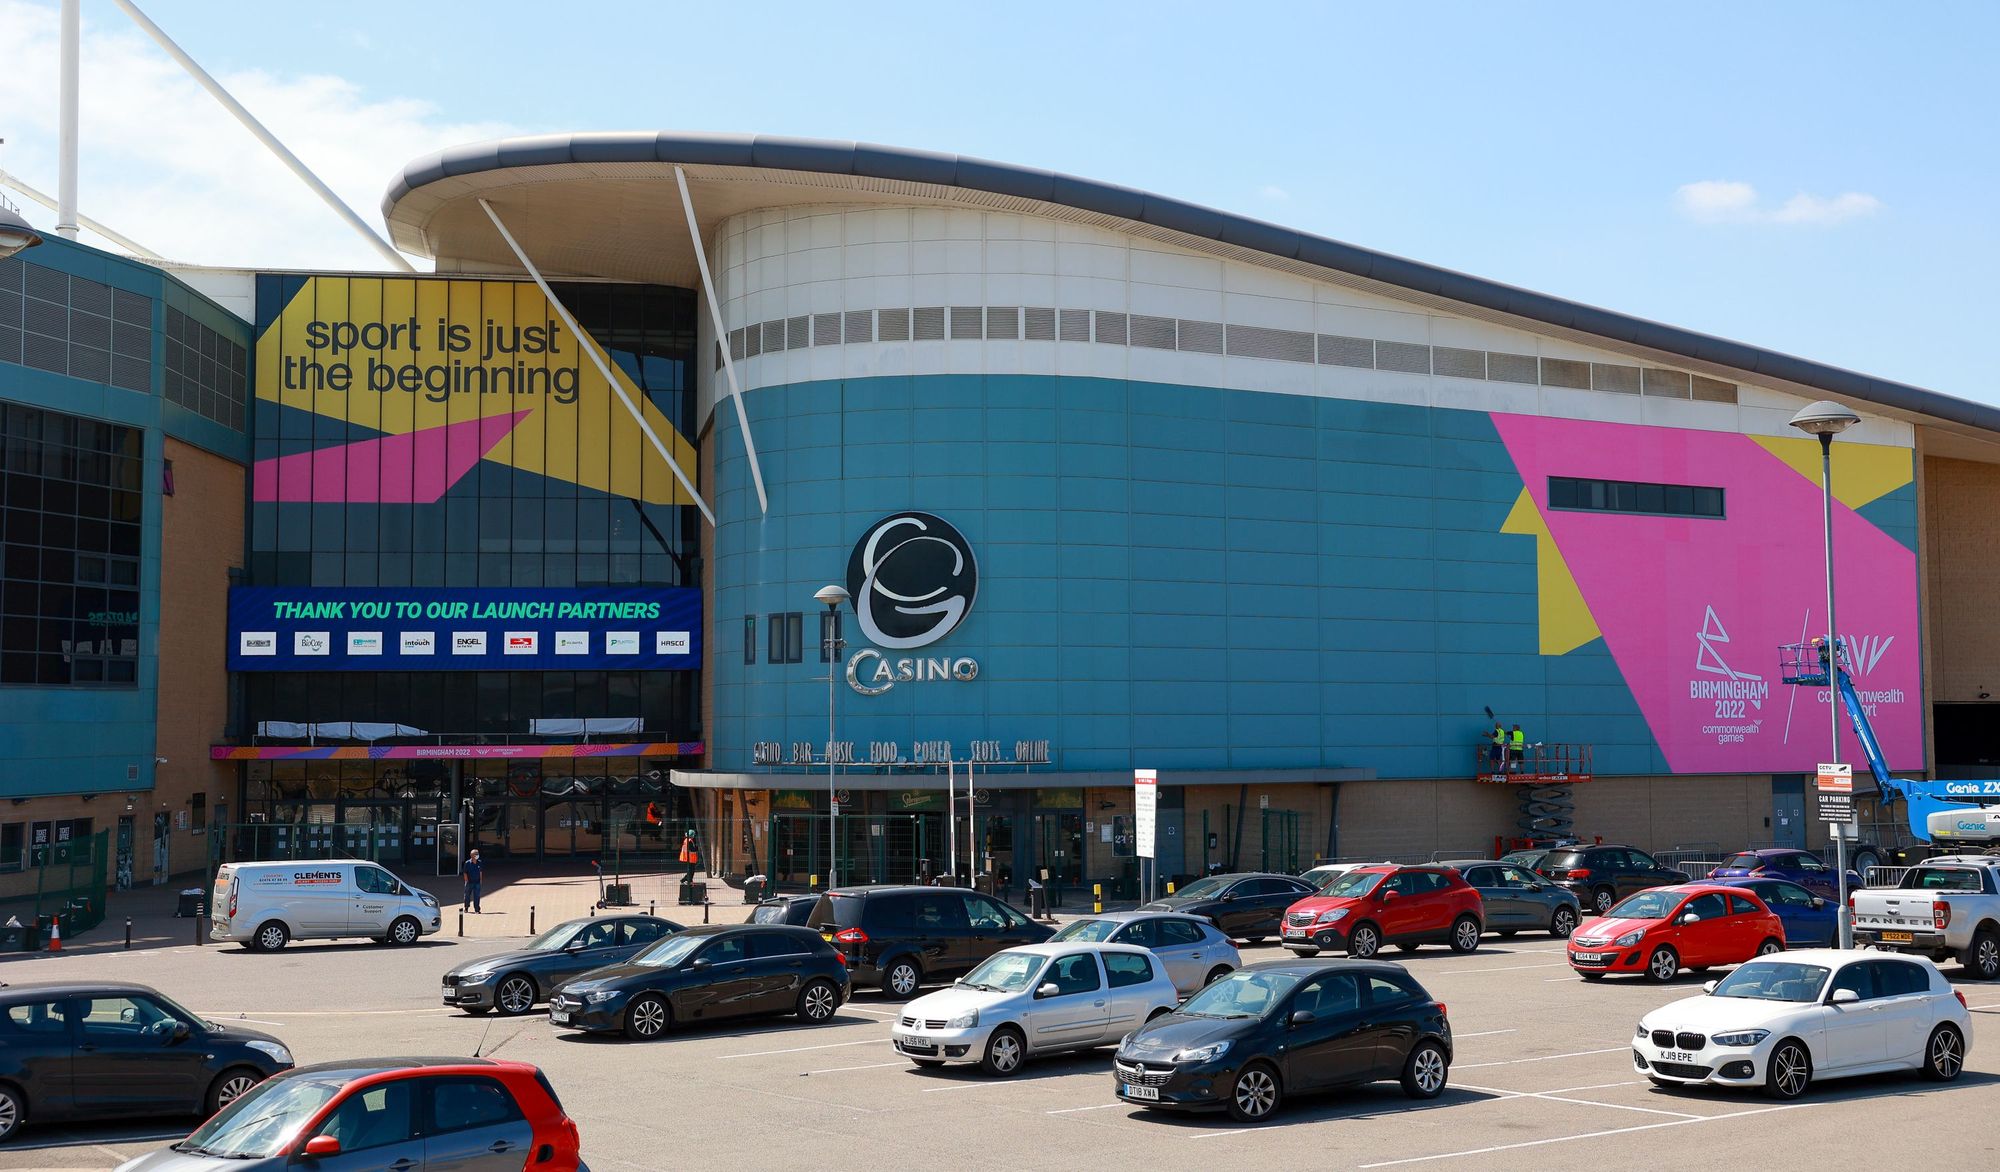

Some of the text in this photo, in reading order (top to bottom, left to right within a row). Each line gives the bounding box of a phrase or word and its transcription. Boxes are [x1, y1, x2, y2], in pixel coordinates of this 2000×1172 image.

[305, 316, 561, 361] sport is just
[284, 356, 579, 404] the beginning
[273, 602, 661, 619] THANK YOU TO OUR LAUNCH PARTNERS
[1690, 680, 1769, 700] BIRMINGHAM
[1715, 700, 1746, 719] 2022
[1702, 723, 1759, 734] commonwealth
[1718, 733, 1745, 745] games
[455, 748, 471, 756] 2022
[793, 742, 812, 762] BAR
[870, 741, 897, 762] FOOD
[913, 740, 952, 762] POKER
[970, 740, 1001, 761] SLOTS
[1015, 740, 1050, 761] ONLINE
[1946, 782, 1980, 794] Genie
[1957, 820, 1986, 831] Genie
[294, 871, 342, 879] CLEMENTS
[1858, 917, 1933, 926] RANGER
[1660, 1050, 1693, 1062] KJ19 EPE
[1129, 1085, 1156, 1098] DT18 XWA
